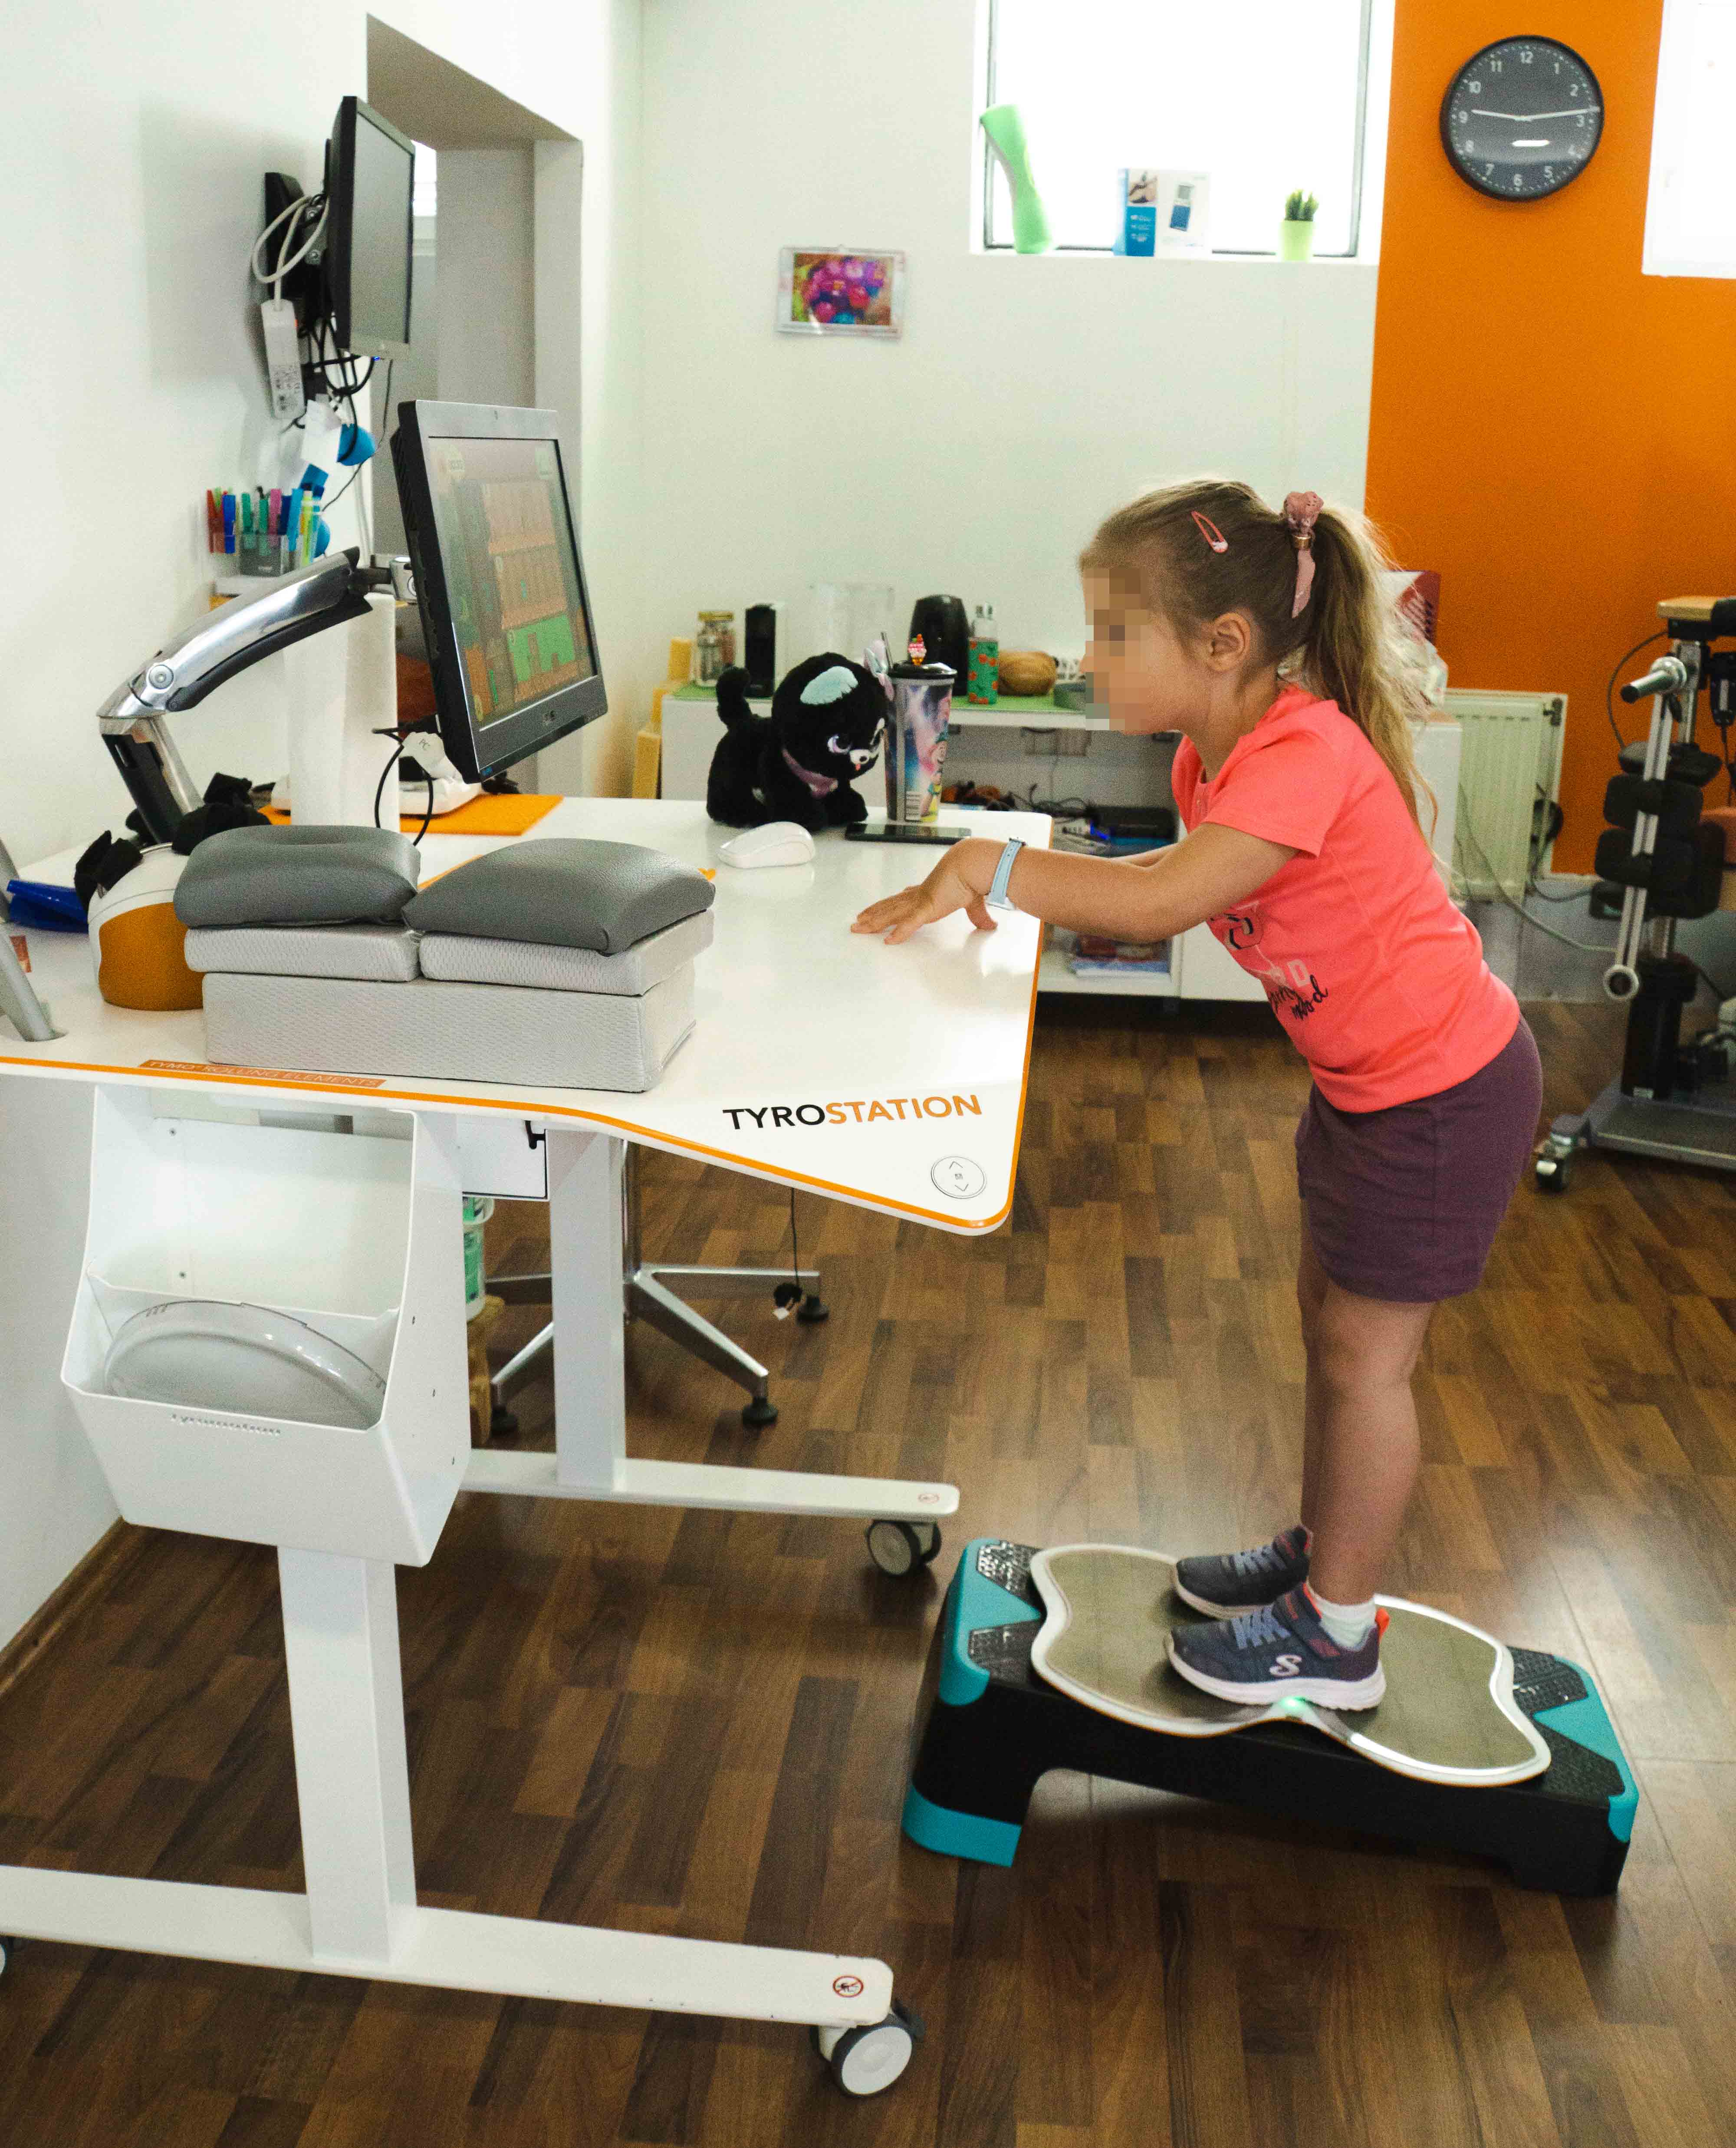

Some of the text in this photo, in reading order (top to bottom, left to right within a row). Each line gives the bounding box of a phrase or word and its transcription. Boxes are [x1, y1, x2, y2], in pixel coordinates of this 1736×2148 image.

[1520, 51, 1533, 64] 12
[1490, 60, 1502, 72] 11
[1554, 63, 1559, 74] 1
[1469, 80, 1481, 94] 10
[1570, 84, 1578, 96] 2
[1459, 111, 1468, 124] 9
[1576, 115, 1584, 127] 3
[1465, 140, 1474, 153] 8
[1568, 145, 1575, 155] 4
[1486, 163, 1494, 175] 7
[1545, 166, 1552, 178] 5
[1513, 174, 1522, 186] 6
[283, 1072, 378, 1086] ELEMENTS
[722, 1094, 982, 1130] TYROSTATION
